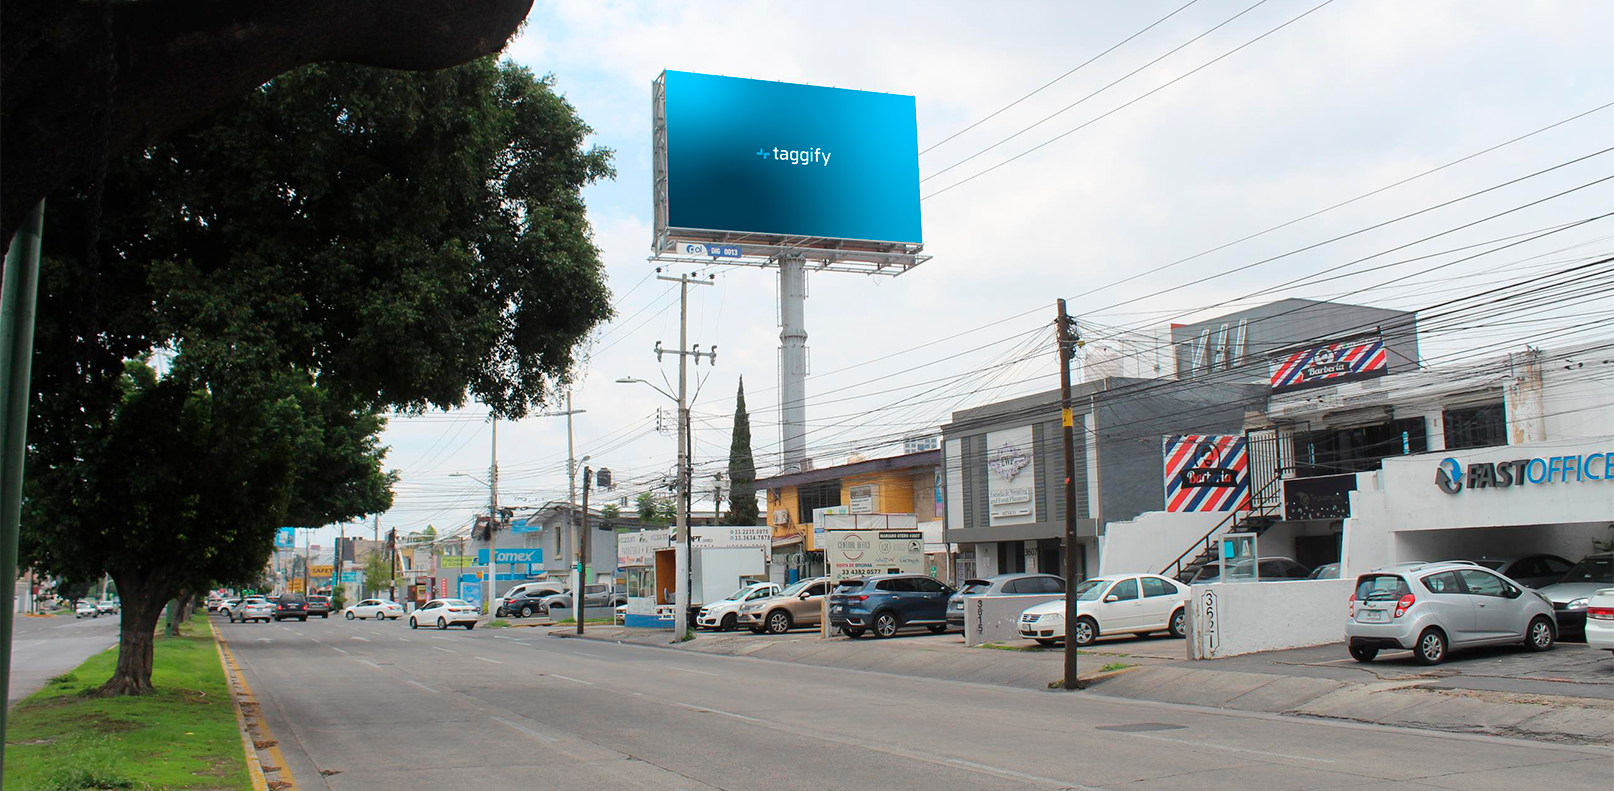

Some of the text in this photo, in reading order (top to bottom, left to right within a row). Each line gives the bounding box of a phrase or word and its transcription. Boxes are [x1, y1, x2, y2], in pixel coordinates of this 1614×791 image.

[772, 146, 832, 167] taggify
[724, 248, 738, 256] 0013
[857, 541, 871, 549] OFFICE
[495, 550, 536, 562] omex
[1025, 547, 1038, 557] 3607
